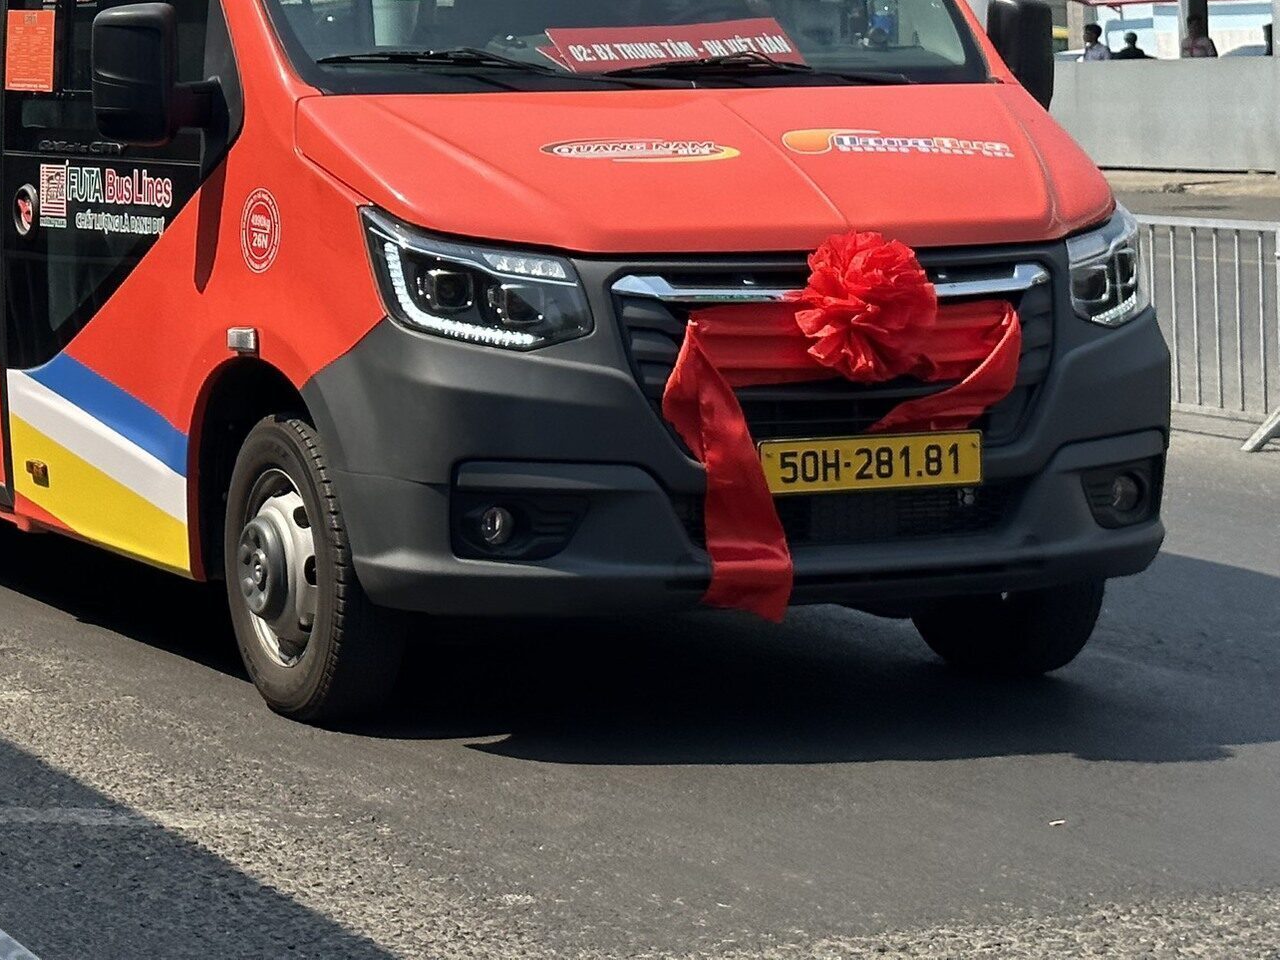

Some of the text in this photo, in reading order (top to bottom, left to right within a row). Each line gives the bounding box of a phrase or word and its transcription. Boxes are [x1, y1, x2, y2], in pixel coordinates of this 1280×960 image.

[568, 44, 597, 62] 02:
[591, 43, 620, 60] BX
[613, 42, 667, 60] TRUNG
[660, 38, 699, 58] TÂM
[754, 32, 792, 54] HÀN
[66, 166, 173, 208] FUTA Bus Lines
